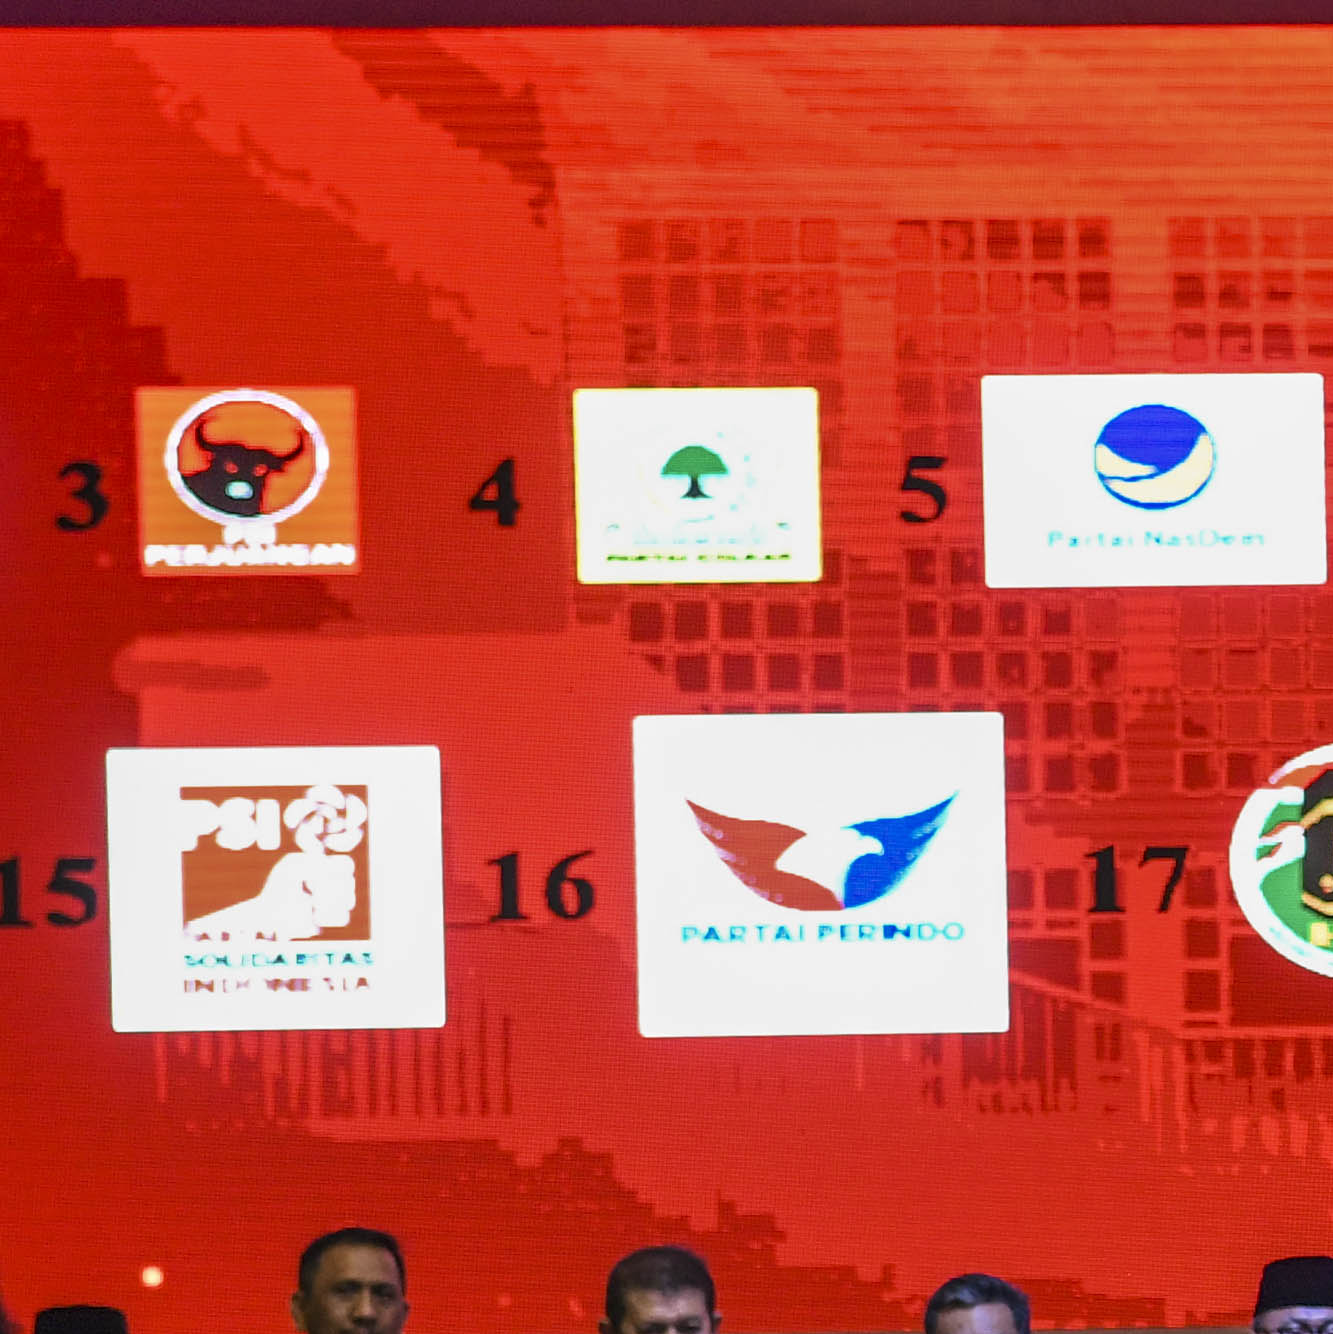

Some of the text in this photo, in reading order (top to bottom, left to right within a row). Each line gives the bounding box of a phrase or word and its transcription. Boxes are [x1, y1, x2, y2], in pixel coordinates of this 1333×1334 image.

[56, 460, 109, 531] 3
[468, 457, 521, 526] 4
[900, 455, 948, 522] 5
[0, 856, 98, 927] 15
[487, 849, 596, 923] 16
[1083, 844, 1190, 914] 17
[681, 921, 965, 944] PARTAI PERINDO
